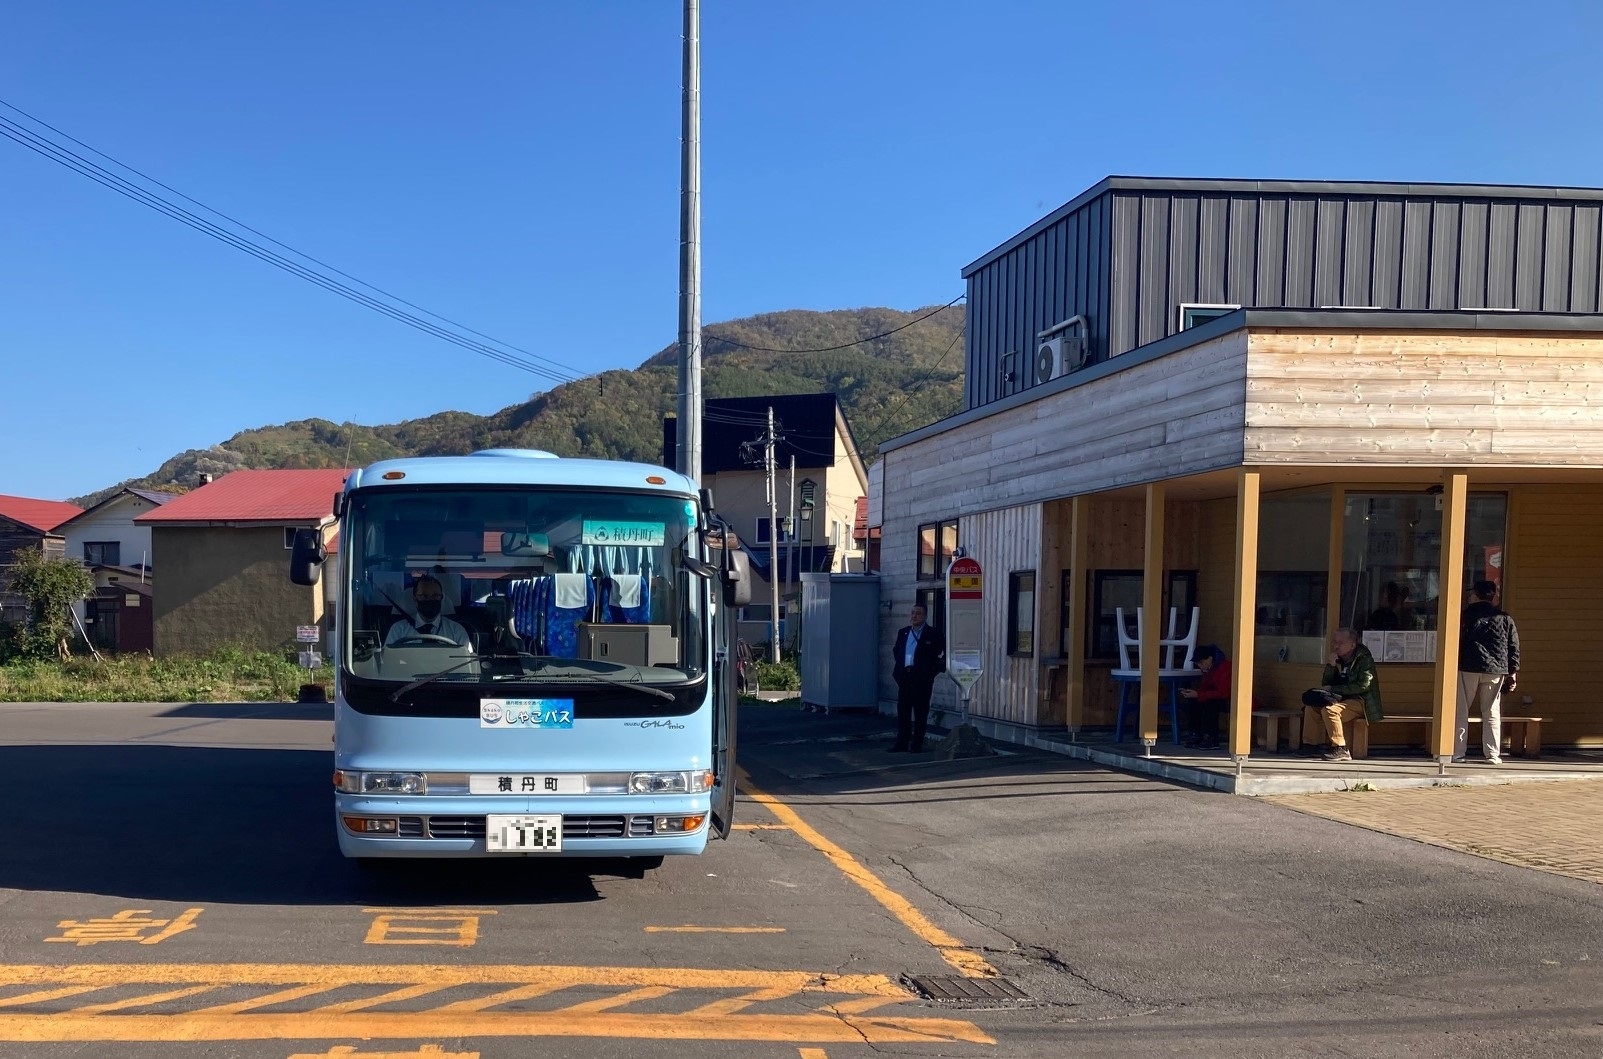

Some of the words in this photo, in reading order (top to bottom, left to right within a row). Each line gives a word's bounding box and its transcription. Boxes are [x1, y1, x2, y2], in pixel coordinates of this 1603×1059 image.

[613, 527, 655, 542] 積丹町
[506, 709, 571, 725] しゃこバス
[497, 776, 559, 792] 積丹町
